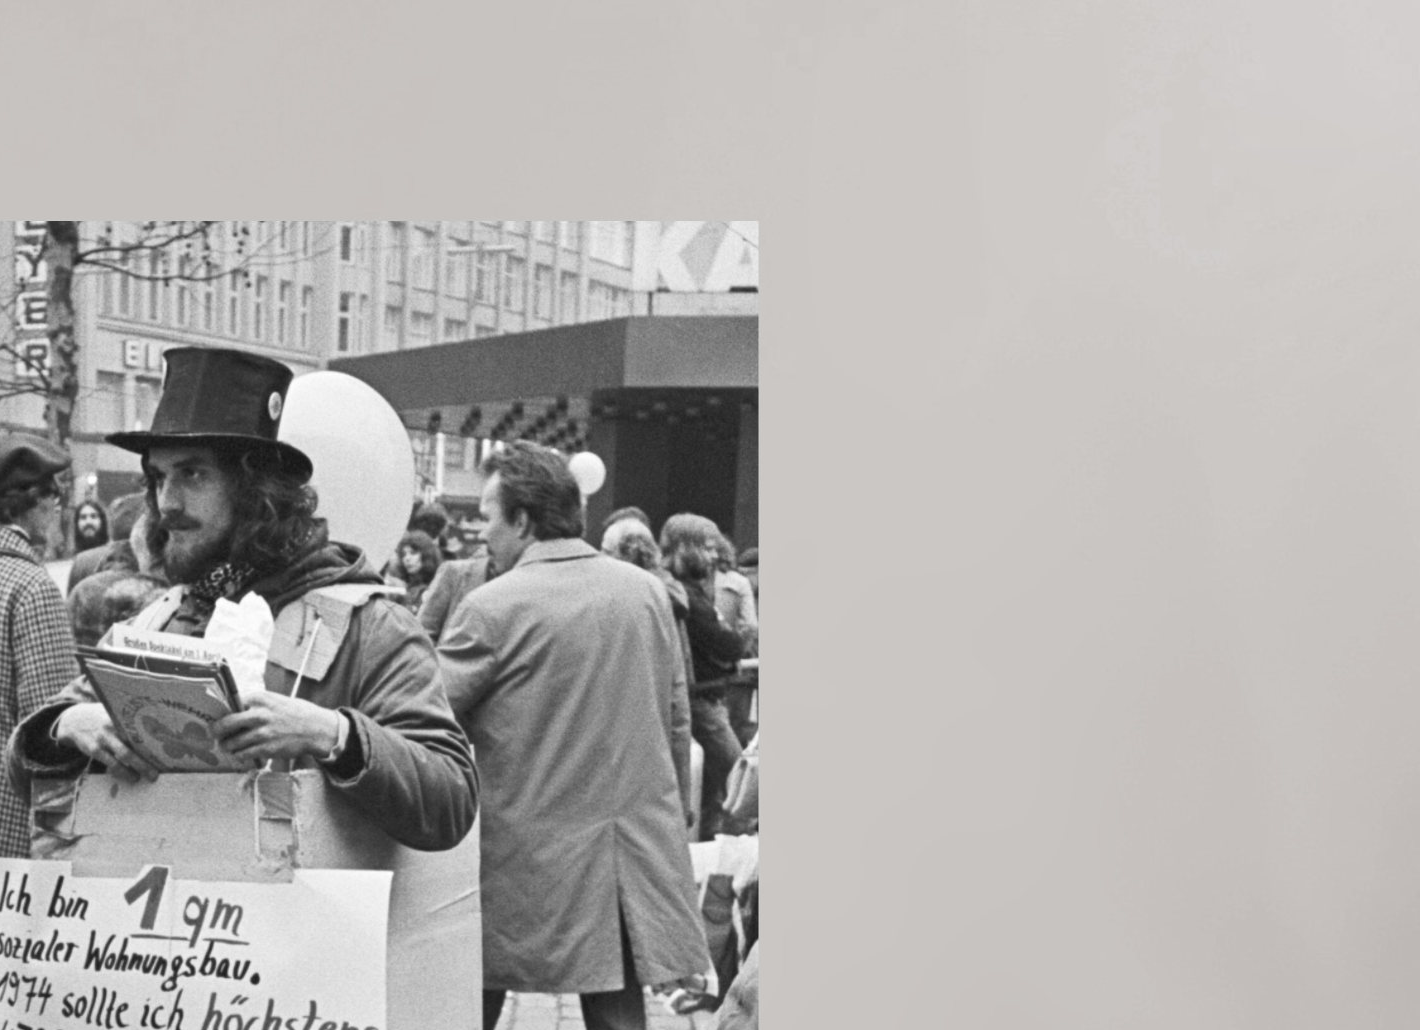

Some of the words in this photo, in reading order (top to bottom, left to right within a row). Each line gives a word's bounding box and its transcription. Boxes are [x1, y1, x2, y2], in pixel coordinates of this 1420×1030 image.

[47, 875, 88, 921] bin
[124, 865, 169, 930] 1
[182, 894, 244, 948] qm
[84, 929, 261, 991] Wohnungsbau.
[61, 985, 129, 1028] sollte
